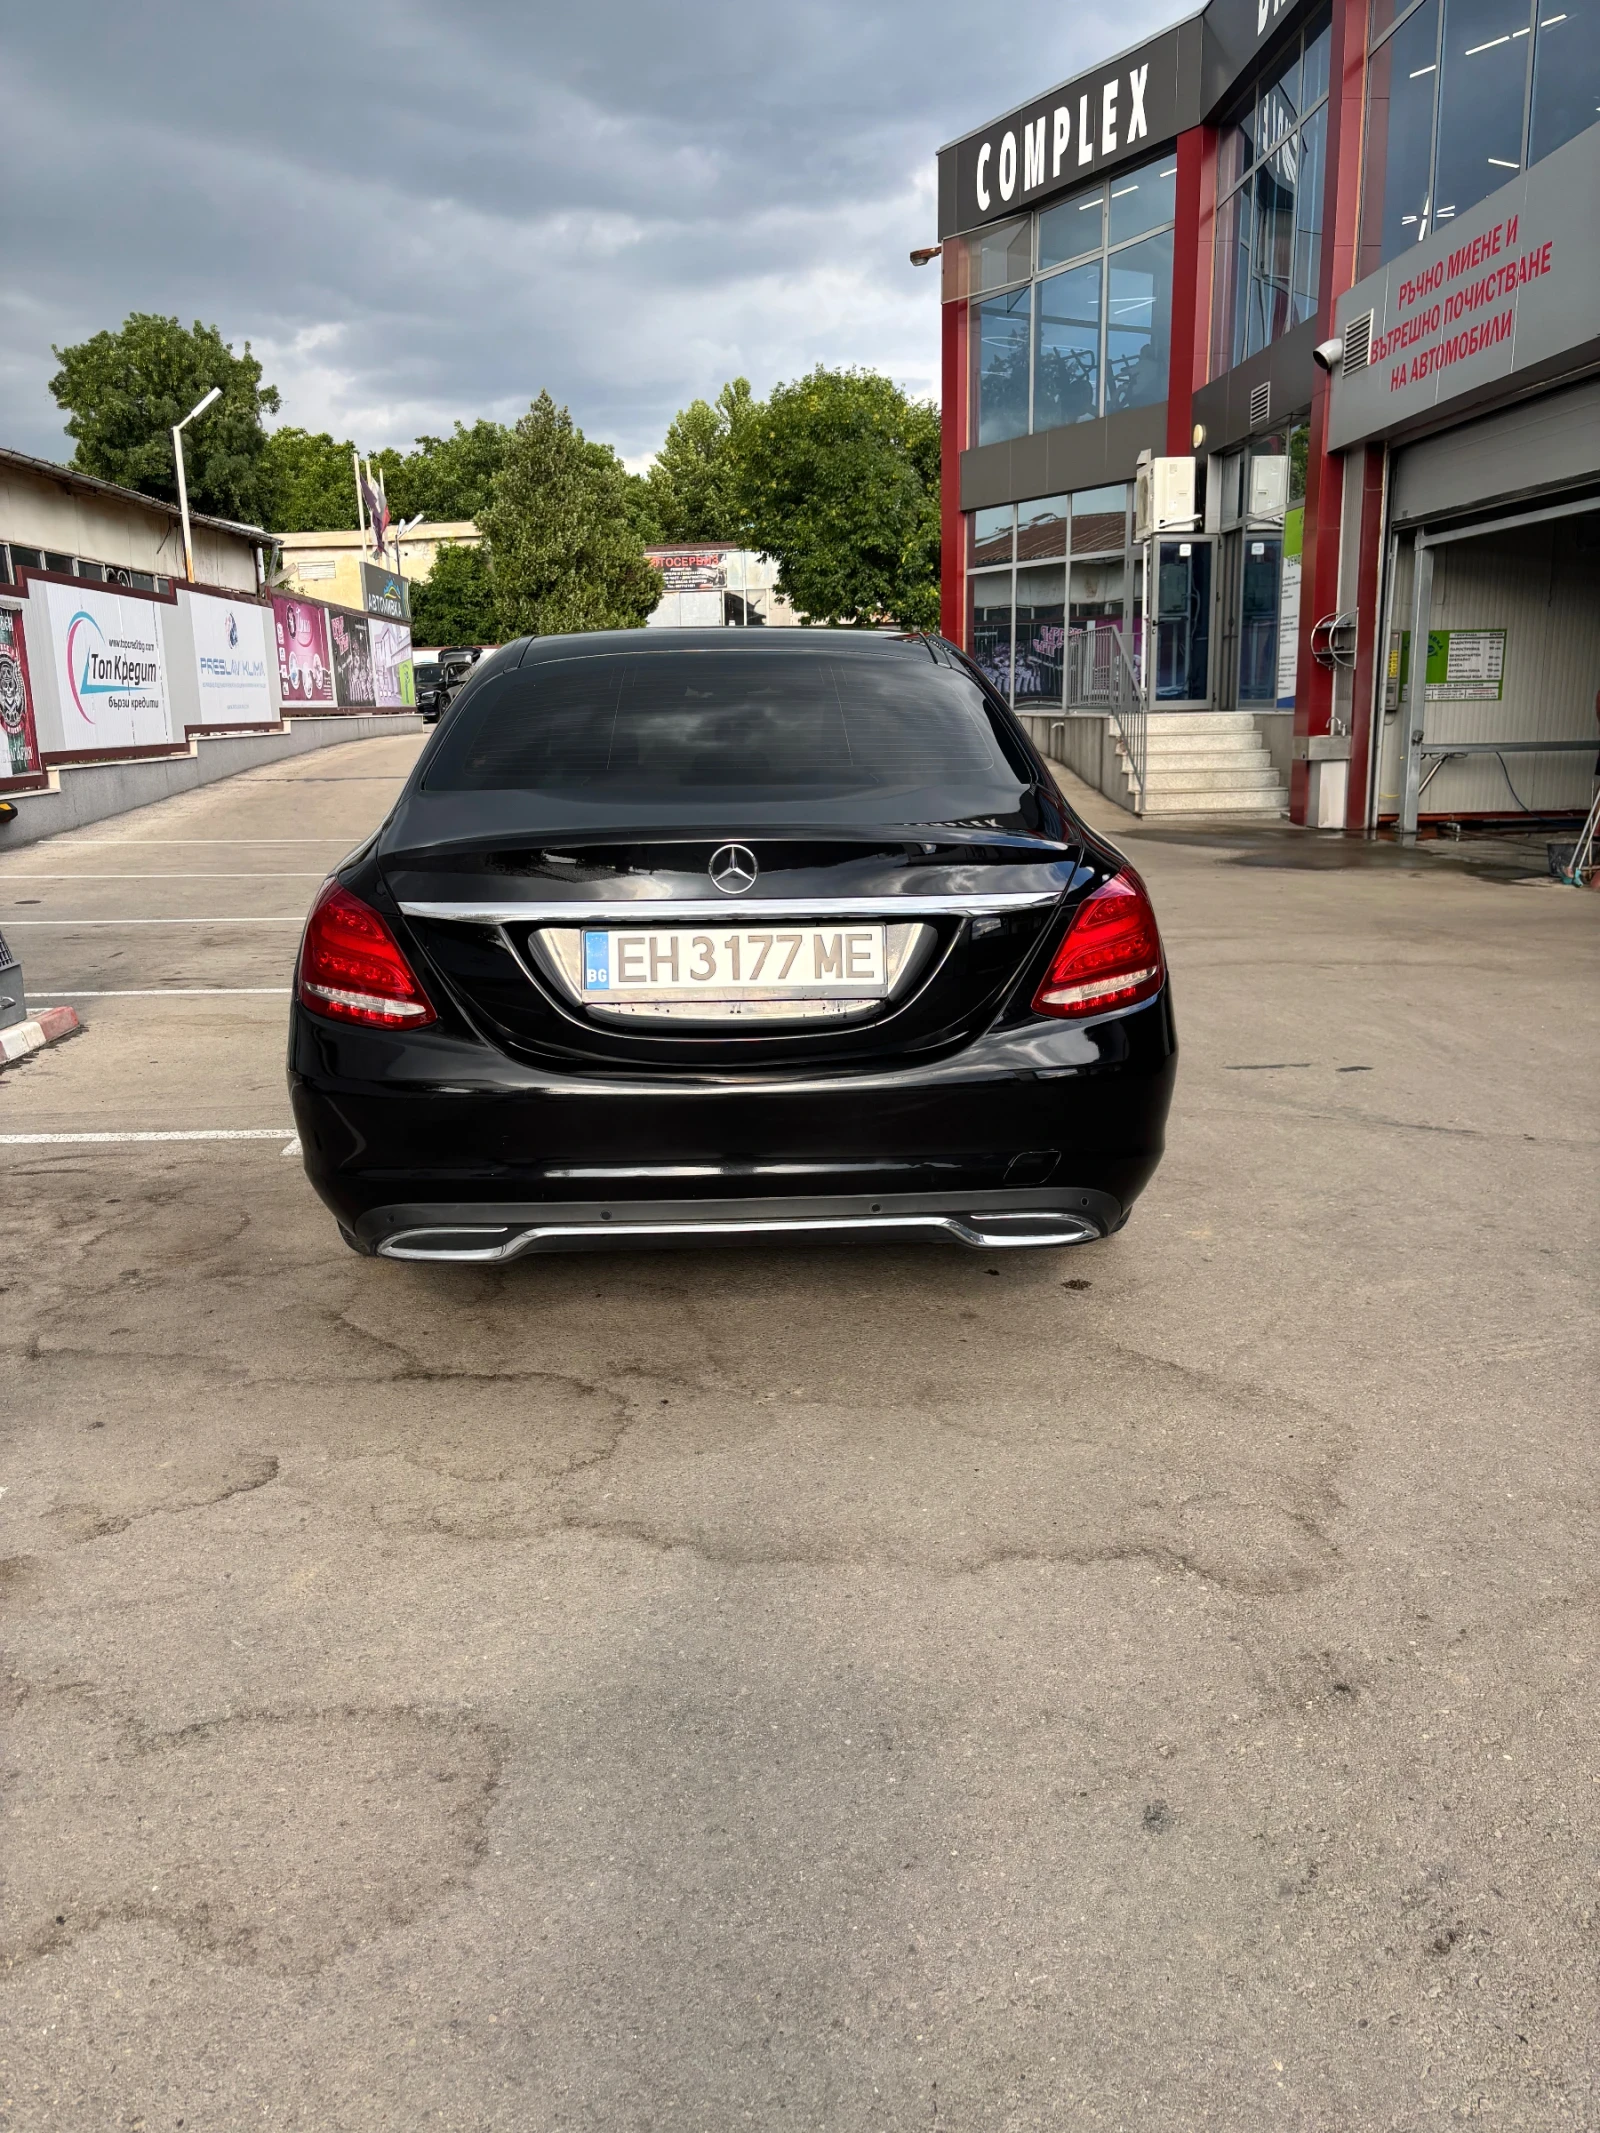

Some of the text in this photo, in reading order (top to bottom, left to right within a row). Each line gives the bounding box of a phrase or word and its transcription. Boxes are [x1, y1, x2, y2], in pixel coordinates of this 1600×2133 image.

[976, 62, 1149, 211] COMPLEX
[1398, 214, 1519, 311] РЪЧНО МИЕНЕ И
[1370, 241, 1553, 365] ВЪТРЕШНО ПОЧИСТВАНЕ
[1390, 309, 1513, 392] НА АВТОМОБИЛИ
[368, 593, 402, 617] АВТОМИВКА
[91, 653, 157, 685] Топ Кредит
[200, 657, 239, 676] PRESLAV
[108, 696, 159, 710] бързи кредити
[587, 968, 607, 983] BG
[618, 934, 875, 982] EH 3177 ME
